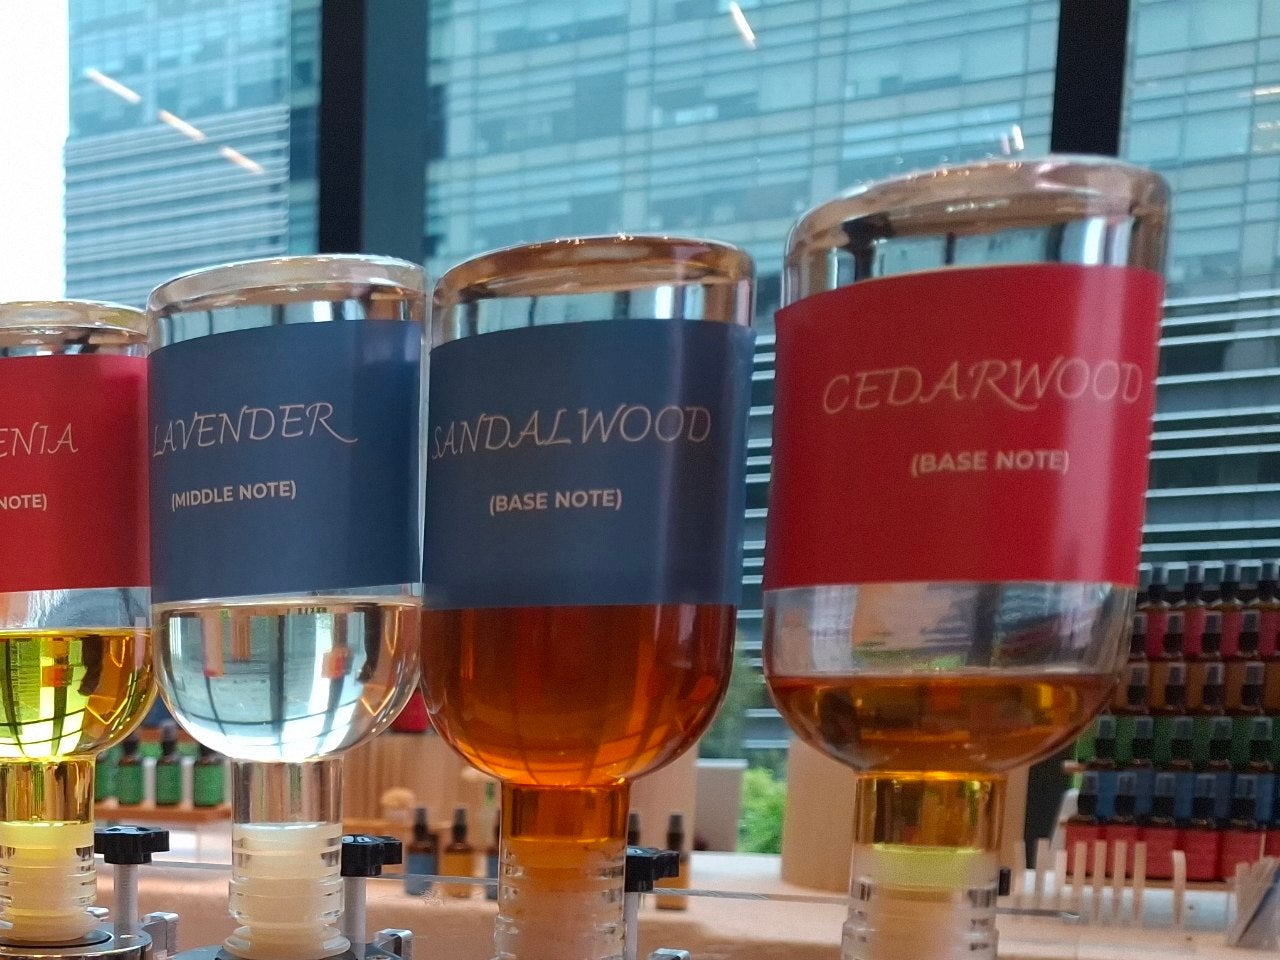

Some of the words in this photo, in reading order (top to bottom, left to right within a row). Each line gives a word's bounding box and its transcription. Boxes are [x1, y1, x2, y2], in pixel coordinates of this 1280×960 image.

[824, 356, 1142, 414] CEDARWOOD
[153, 402, 358, 457] LAVENDER
[911, 453, 987, 478] (BASE
[995, 450, 1070, 475] NOTE)
[171, 486, 234, 512] (MIDDLE
[239, 480, 297, 500] NOTE)
[489, 492, 548, 516] (BASE
[555, 488, 622, 510] NOTE)
